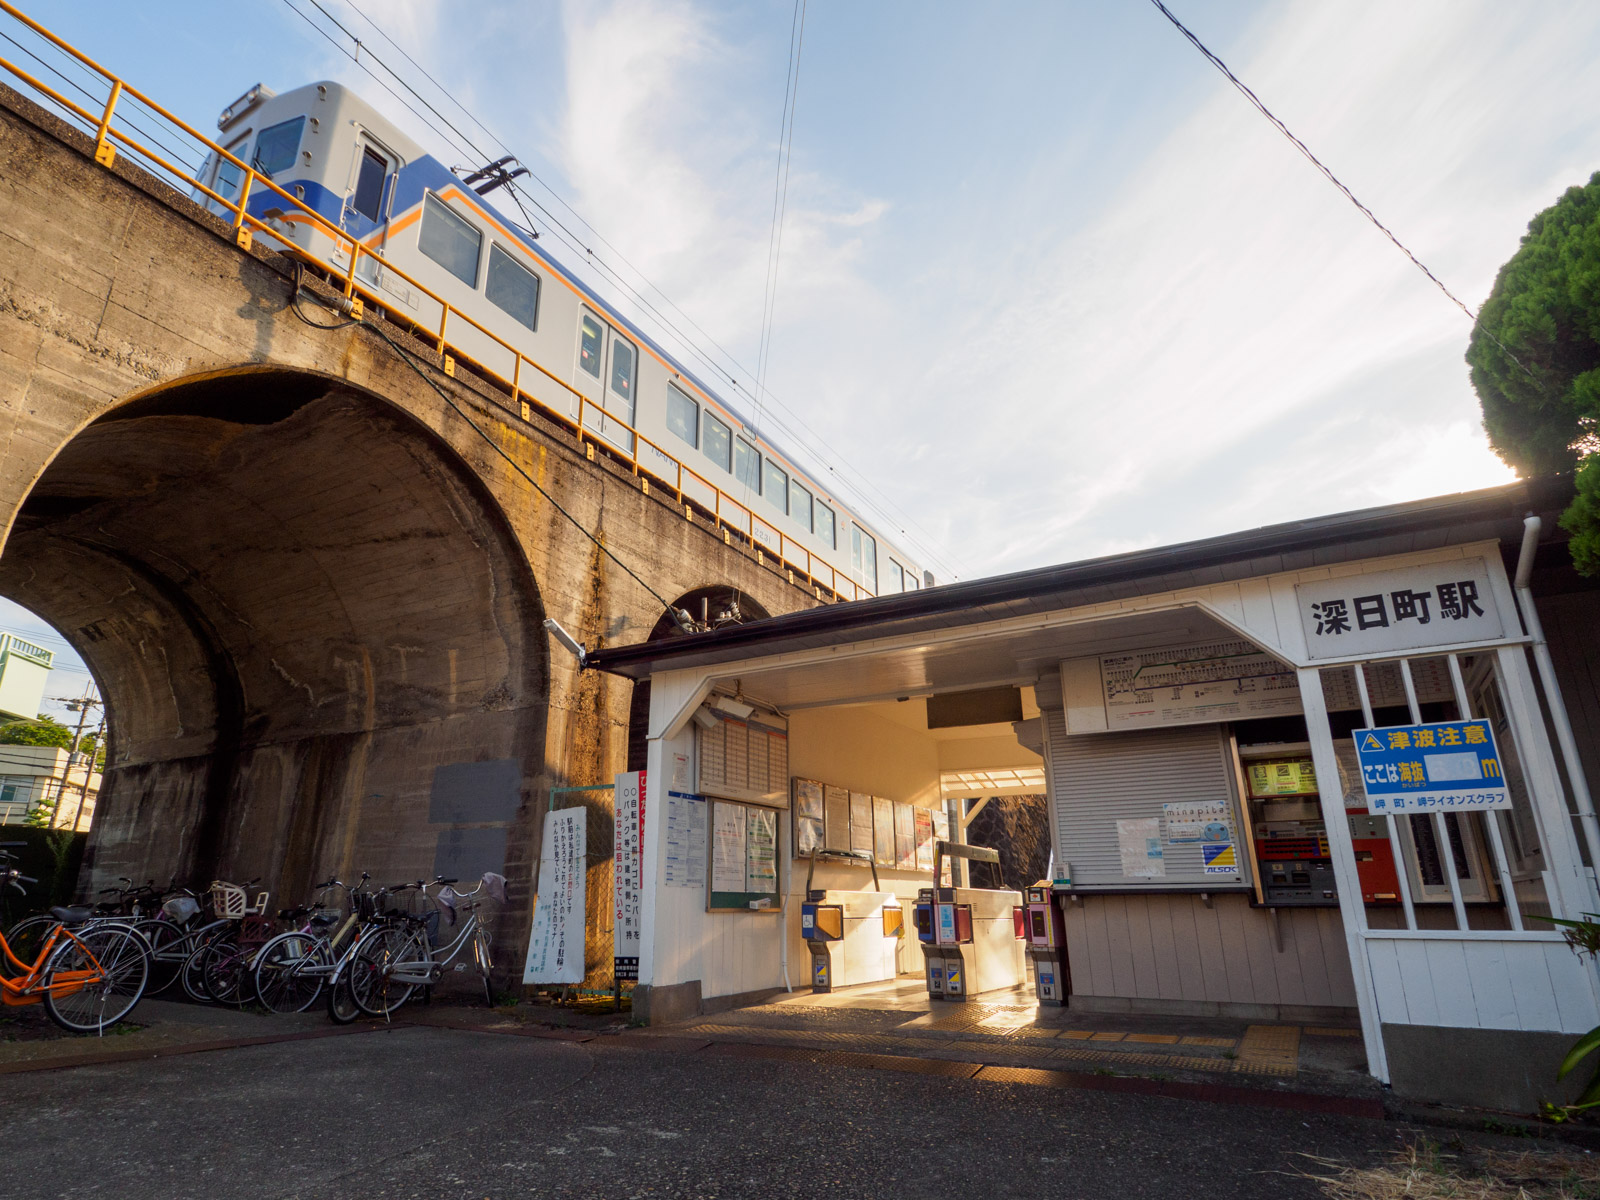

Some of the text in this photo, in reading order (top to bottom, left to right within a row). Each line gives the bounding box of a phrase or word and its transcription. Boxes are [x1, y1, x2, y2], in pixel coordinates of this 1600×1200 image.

[754, 527, 771, 544] 2231
[1311, 580, 1484, 636] 深日町駅
[1387, 725, 1488, 750] 津波注意
[1363, 761, 1426, 784] ここは海抜
[1481, 758, 1500, 778] m
[1166, 806, 1224, 818] minapita
[615, 808, 623, 920] あなたは狙われている
